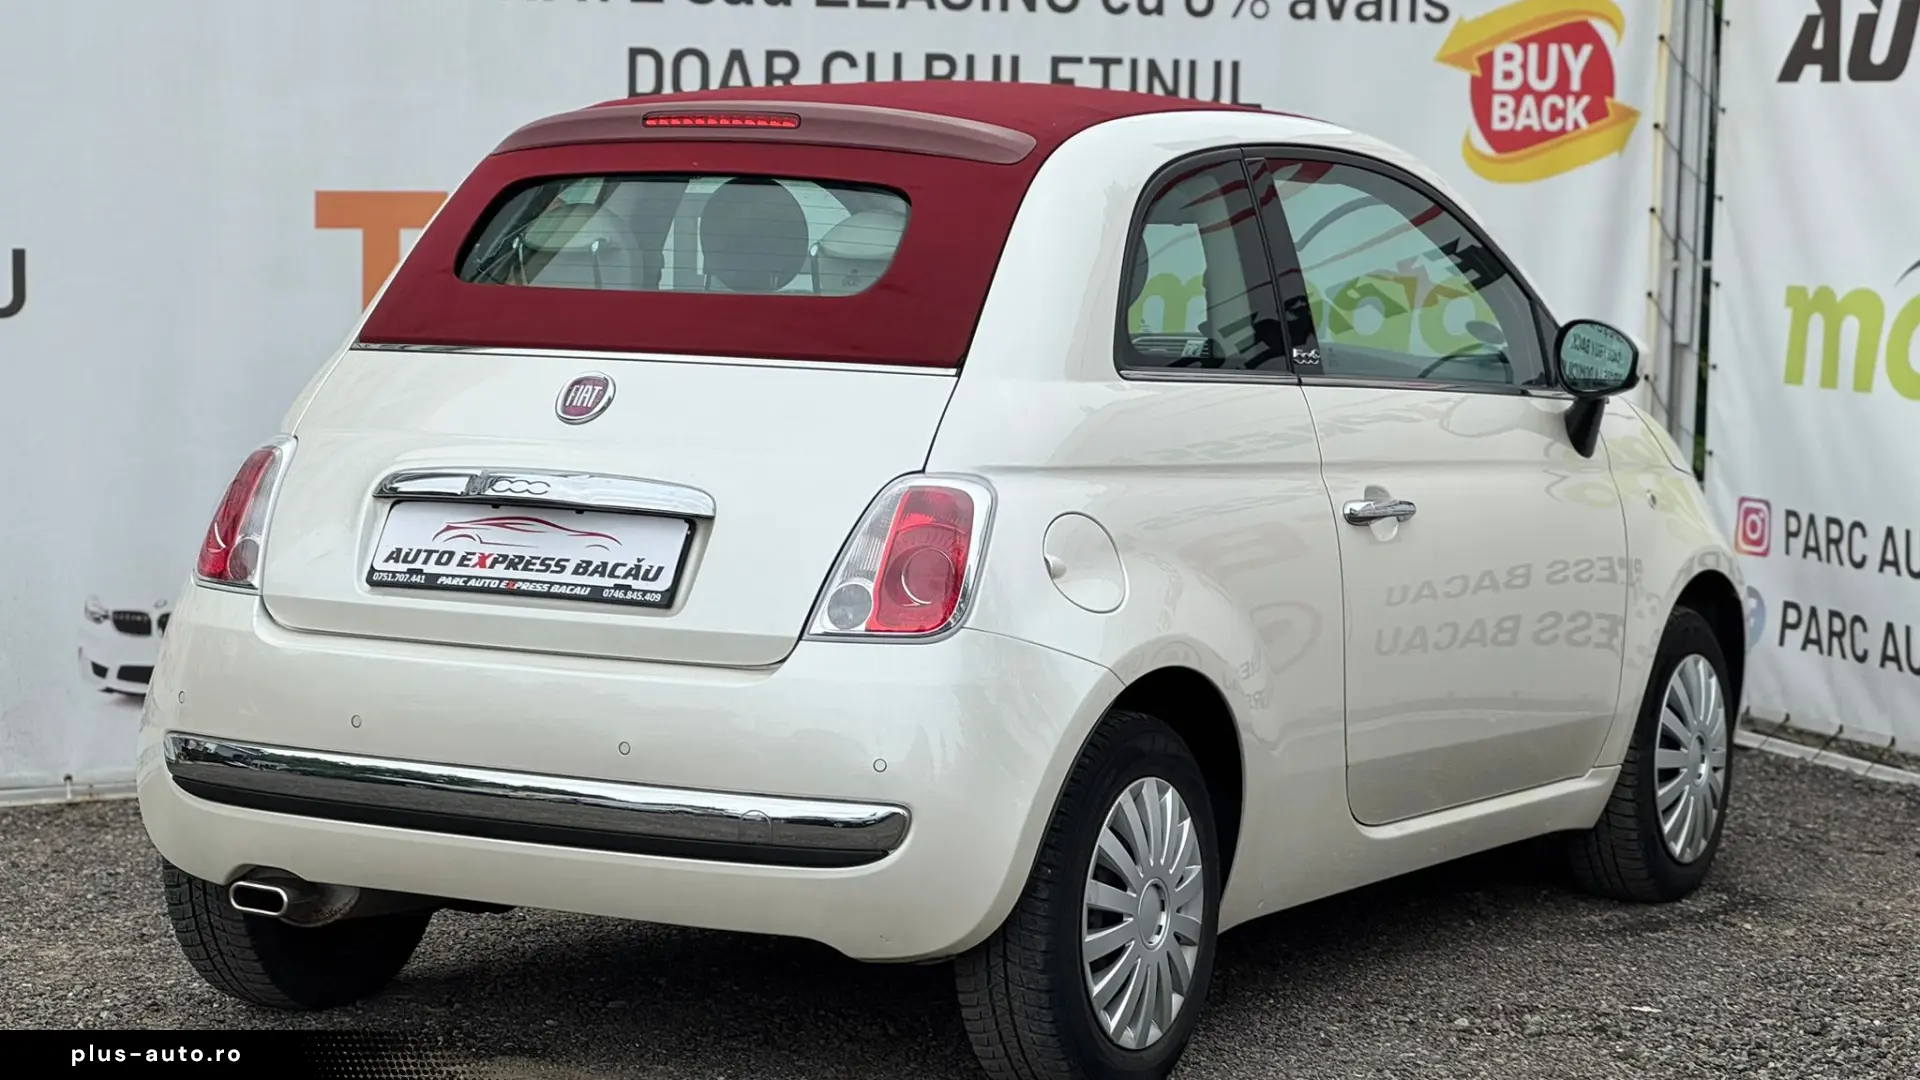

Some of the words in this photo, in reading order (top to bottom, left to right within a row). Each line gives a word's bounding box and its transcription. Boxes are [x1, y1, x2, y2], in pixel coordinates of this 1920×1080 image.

[1492, 42, 1594, 92] BUY
[1491, 93, 1592, 132] BACK
[565, 384, 603, 407] FIAT
[1785, 508, 1868, 569] PARC
[372, 572, 425, 584] 0751.707.441
[383, 547, 456, 567] AUTO
[456, 551, 571, 574] EXPRESS
[571, 557, 665, 583] BACĂU
[436, 575, 466, 587] PARC
[466, 578, 500, 589] AUTO
[499, 580, 551, 593] EXPRESS
[550, 584, 591, 596] BACAU
[602, 589, 662, 602] 0746.845.409
[1779, 600, 1869, 665] PARC
